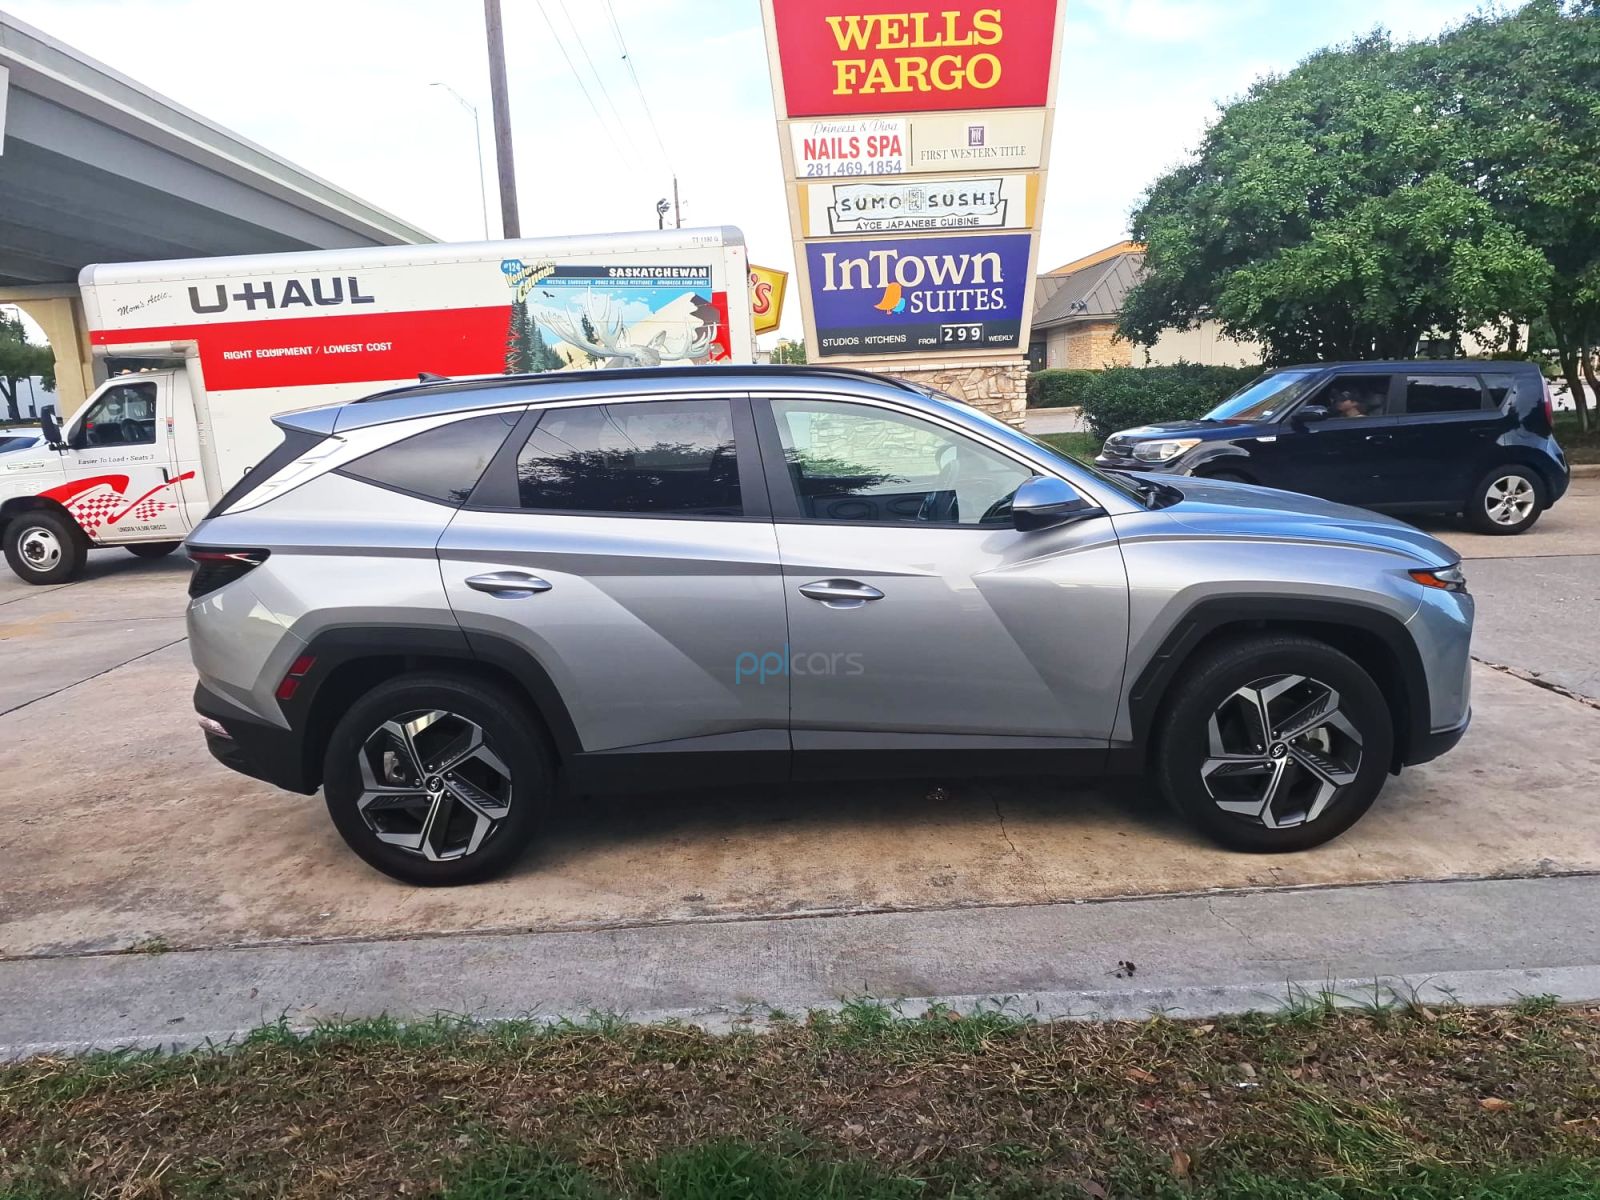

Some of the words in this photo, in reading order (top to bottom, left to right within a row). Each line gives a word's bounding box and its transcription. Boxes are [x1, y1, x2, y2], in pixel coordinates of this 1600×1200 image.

[825, 9, 1003, 51] WELLS
[832, 53, 1002, 95] FARGO
[811, 121, 857, 136] Princess
[859, 123, 867, 132] &
[869, 119, 898, 131] Diva
[803, 136, 861, 161] NAILS
[867, 134, 903, 158] SPA
[920, 149, 949, 161] FIRST
[950, 146, 998, 159] WESTERN
[999, 145, 1027, 157] TITLE
[806, 160, 903, 177] 281.469.1854
[841, 196, 902, 212] SUMO
[928, 191, 996, 208] SUSHI
[855, 221, 883, 231] AYCE
[886, 218, 937, 229] JAPANESE
[940, 217, 980, 226] CUISINE
[608, 266, 707, 278] SASKATCHEWAN
[821, 249, 1004, 291] InTown
[517, 265, 556, 304] Canada
[116, 300, 145, 316] Mom's
[146, 292, 168, 306] Attic
[188, 276, 375, 314] U-HAUL
[822, 337, 860, 347] STUDIOS
[864, 334, 907, 345] KITCHENS
[943, 327, 981, 342] 299
[988, 334, 1014, 343] WEEKLY
[223, 350, 253, 360] RIGHT
[256, 346, 313, 358] EQUIPMENT
[323, 343, 363, 354] LOWEST
[366, 342, 393, 352] COST
